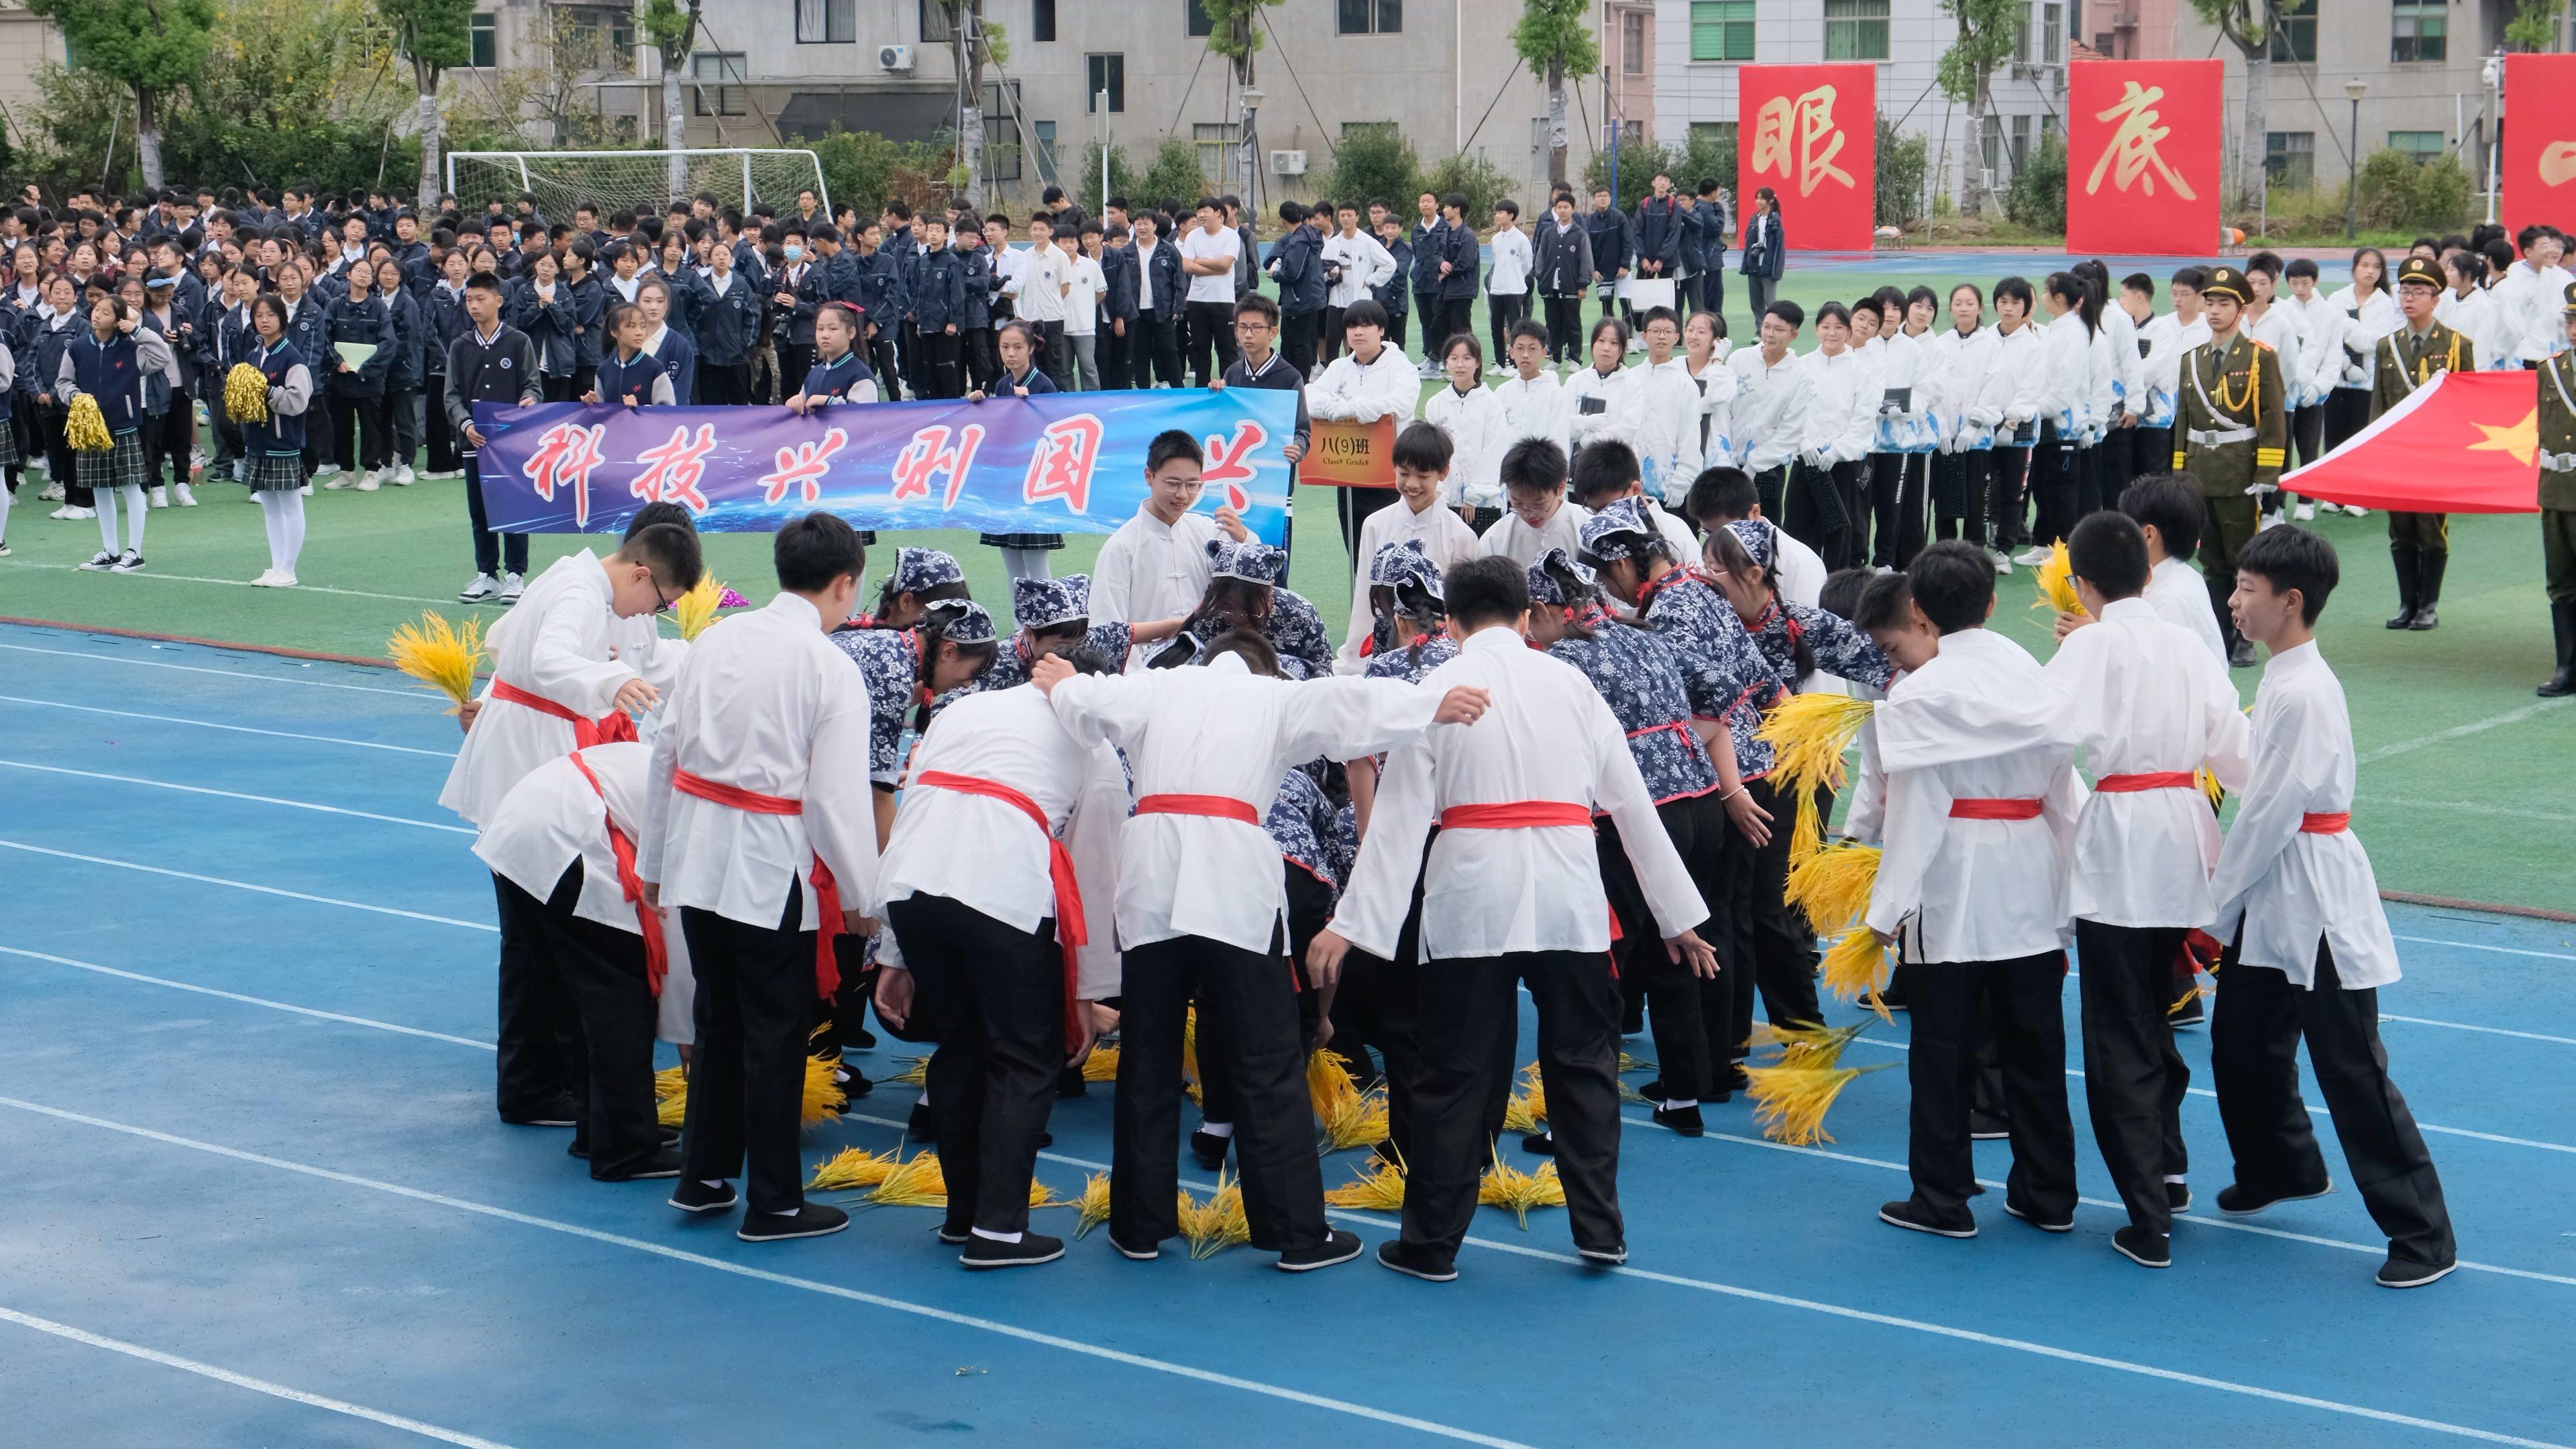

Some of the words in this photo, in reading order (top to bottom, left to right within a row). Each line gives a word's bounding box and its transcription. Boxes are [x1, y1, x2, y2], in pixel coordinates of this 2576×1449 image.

[1752, 84, 1856, 197] 眼
[2085, 80, 2197, 201] 底
[1321, 437, 1370, 455] 八(9)班
[1322, 458, 1343, 466] Class9
[1346, 458, 1369, 466] Grade8
